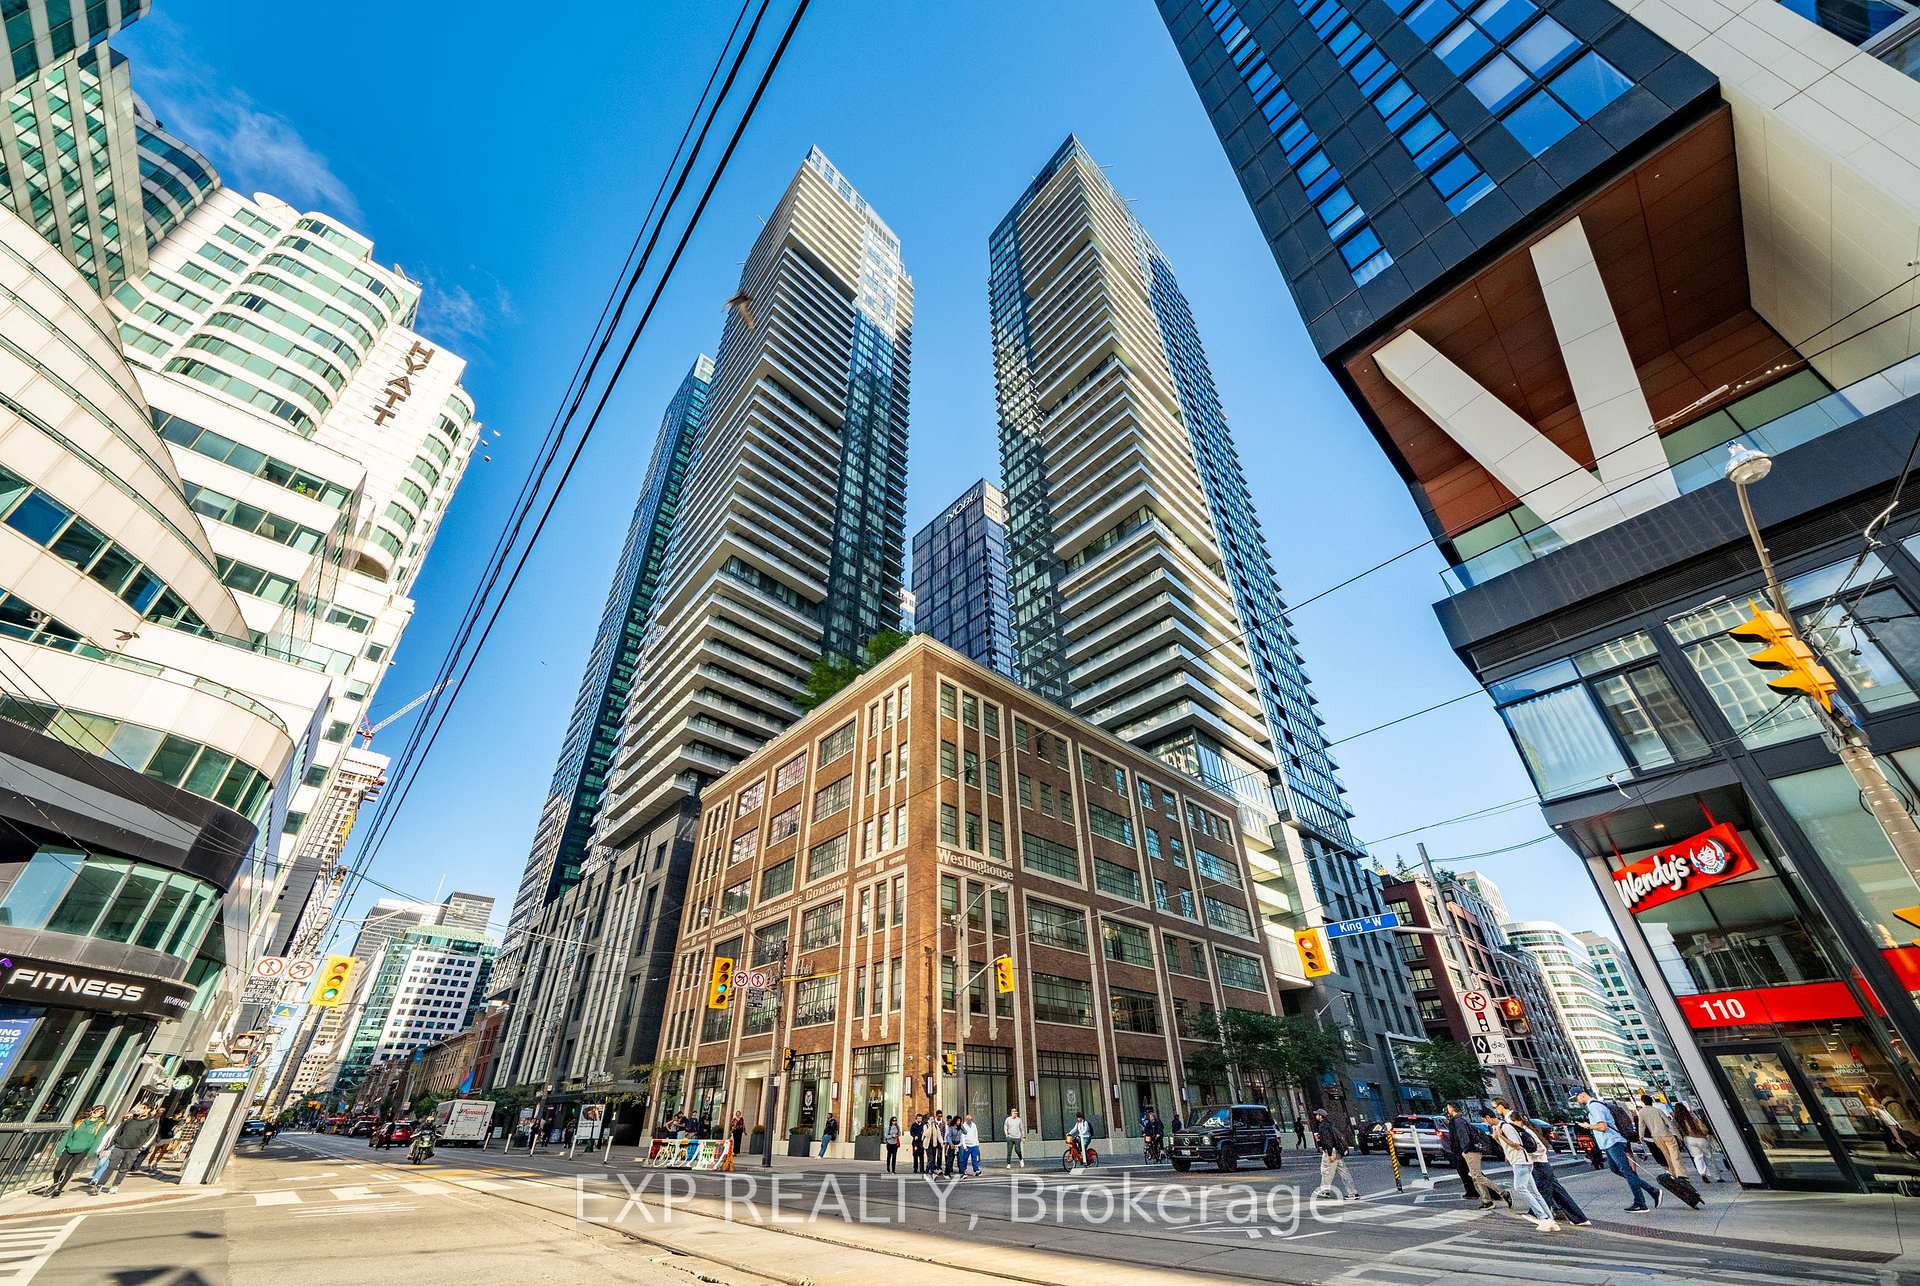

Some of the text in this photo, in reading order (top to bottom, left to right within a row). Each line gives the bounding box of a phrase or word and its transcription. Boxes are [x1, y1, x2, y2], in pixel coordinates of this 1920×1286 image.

[373, 341, 435, 426] HYATT
[945, 488, 980, 523] NOBU
[937, 850, 1014, 880] Westinghouse
[1614, 854, 1690, 909] Wendy's
[710, 876, 849, 938] CANADIAN WESTINGHOUSE COMPANY
[1339, 921, 1363, 933] King
[1371, 915, 1382, 927] W
[8, 968, 146, 1001] FITNESS
[1699, 998, 1746, 1020] 110
